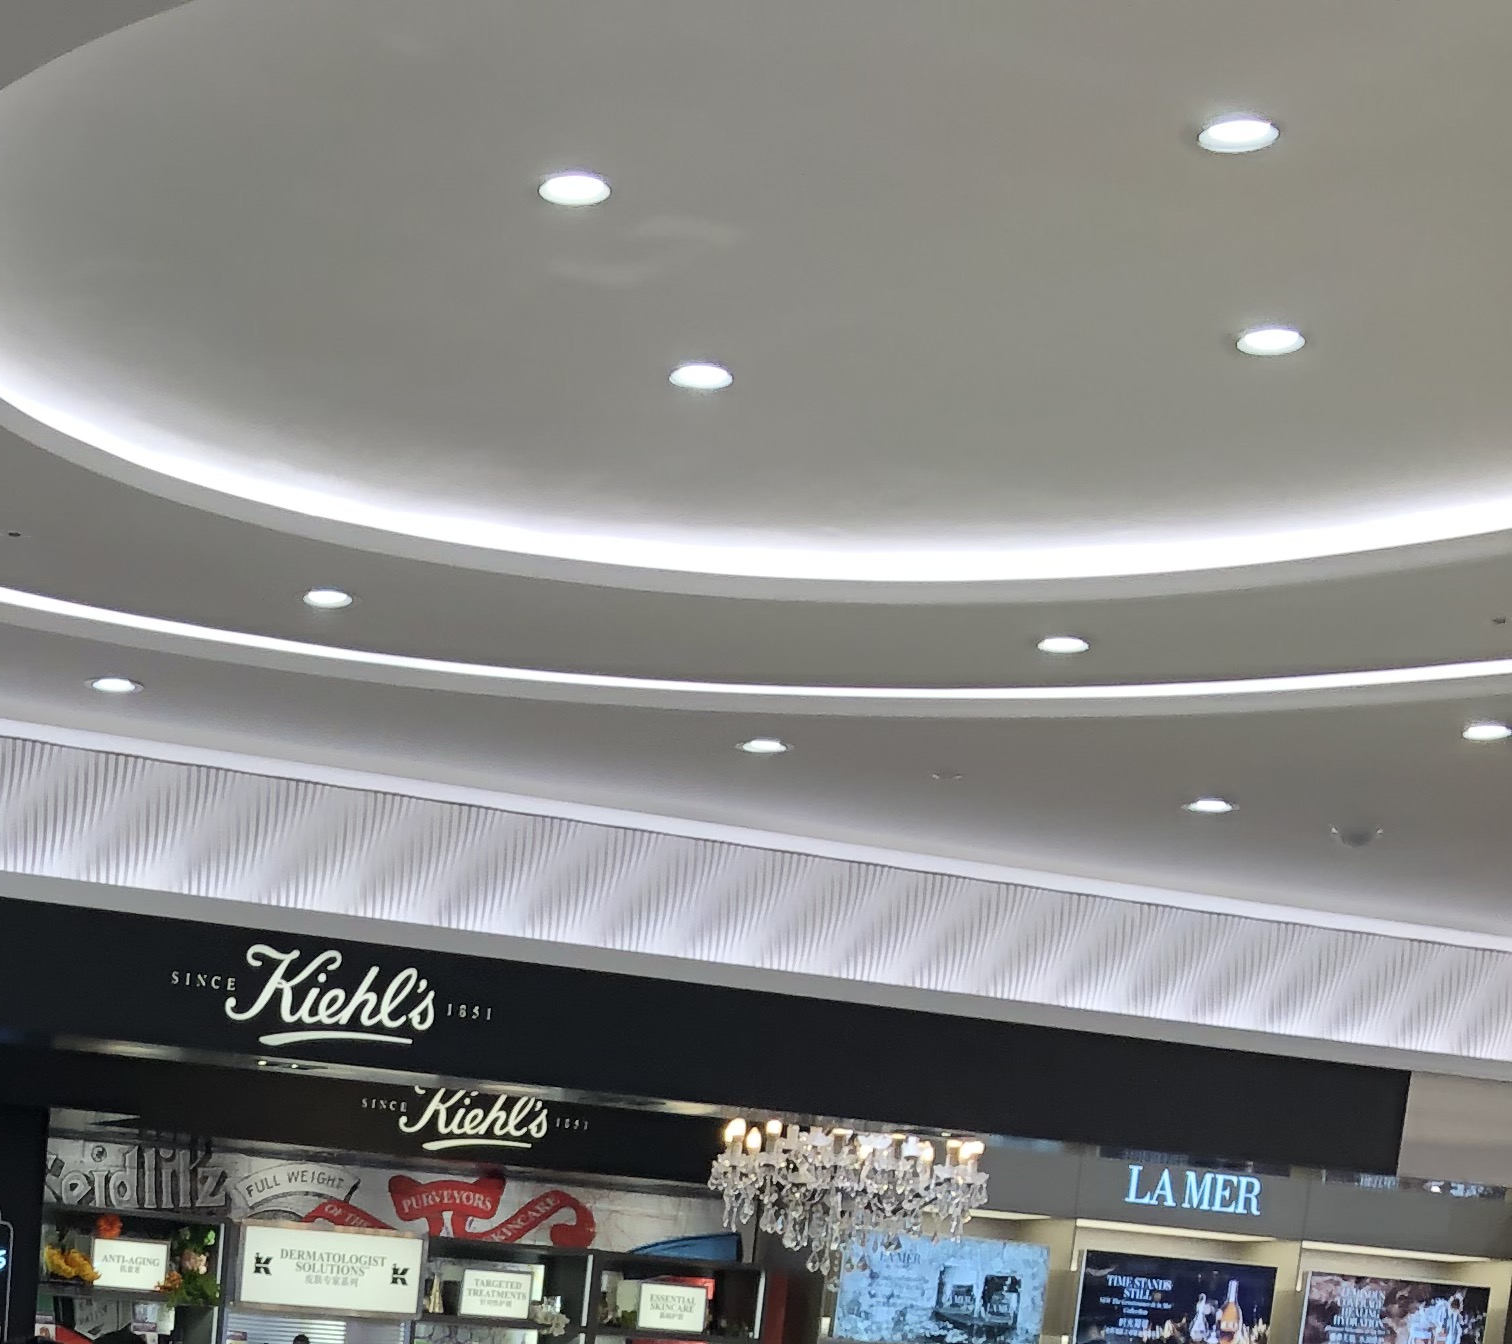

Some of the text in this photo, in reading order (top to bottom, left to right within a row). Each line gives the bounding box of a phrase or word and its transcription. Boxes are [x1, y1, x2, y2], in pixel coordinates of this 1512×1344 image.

[171, 943, 492, 1031] SINCE Kiehl's 1851
[361, 1097, 408, 1113] SINCE
[399, 1085, 548, 1139] Kiehl's
[245, 1169, 345, 1198] FULL WEIGHT
[1123, 1163, 1262, 1216] LA MER
[402, 1189, 493, 1214] PURVEYORS
[101, 1254, 160, 1267] ANTI-AGING
[279, 1248, 388, 1268] DERMATOLOGIST
[295, 1261, 366, 1277] SOLUTIONS
[474, 1278, 522, 1290] TARGETED
[1106, 1274, 1173, 1291] TIME STANDS
[466, 1287, 527, 1300] TREATMENTS
[650, 1293, 696, 1306] ESSENTIAL
[1123, 1287, 1152, 1300] STILL
[649, 1303, 695, 1314] SKINCARE
